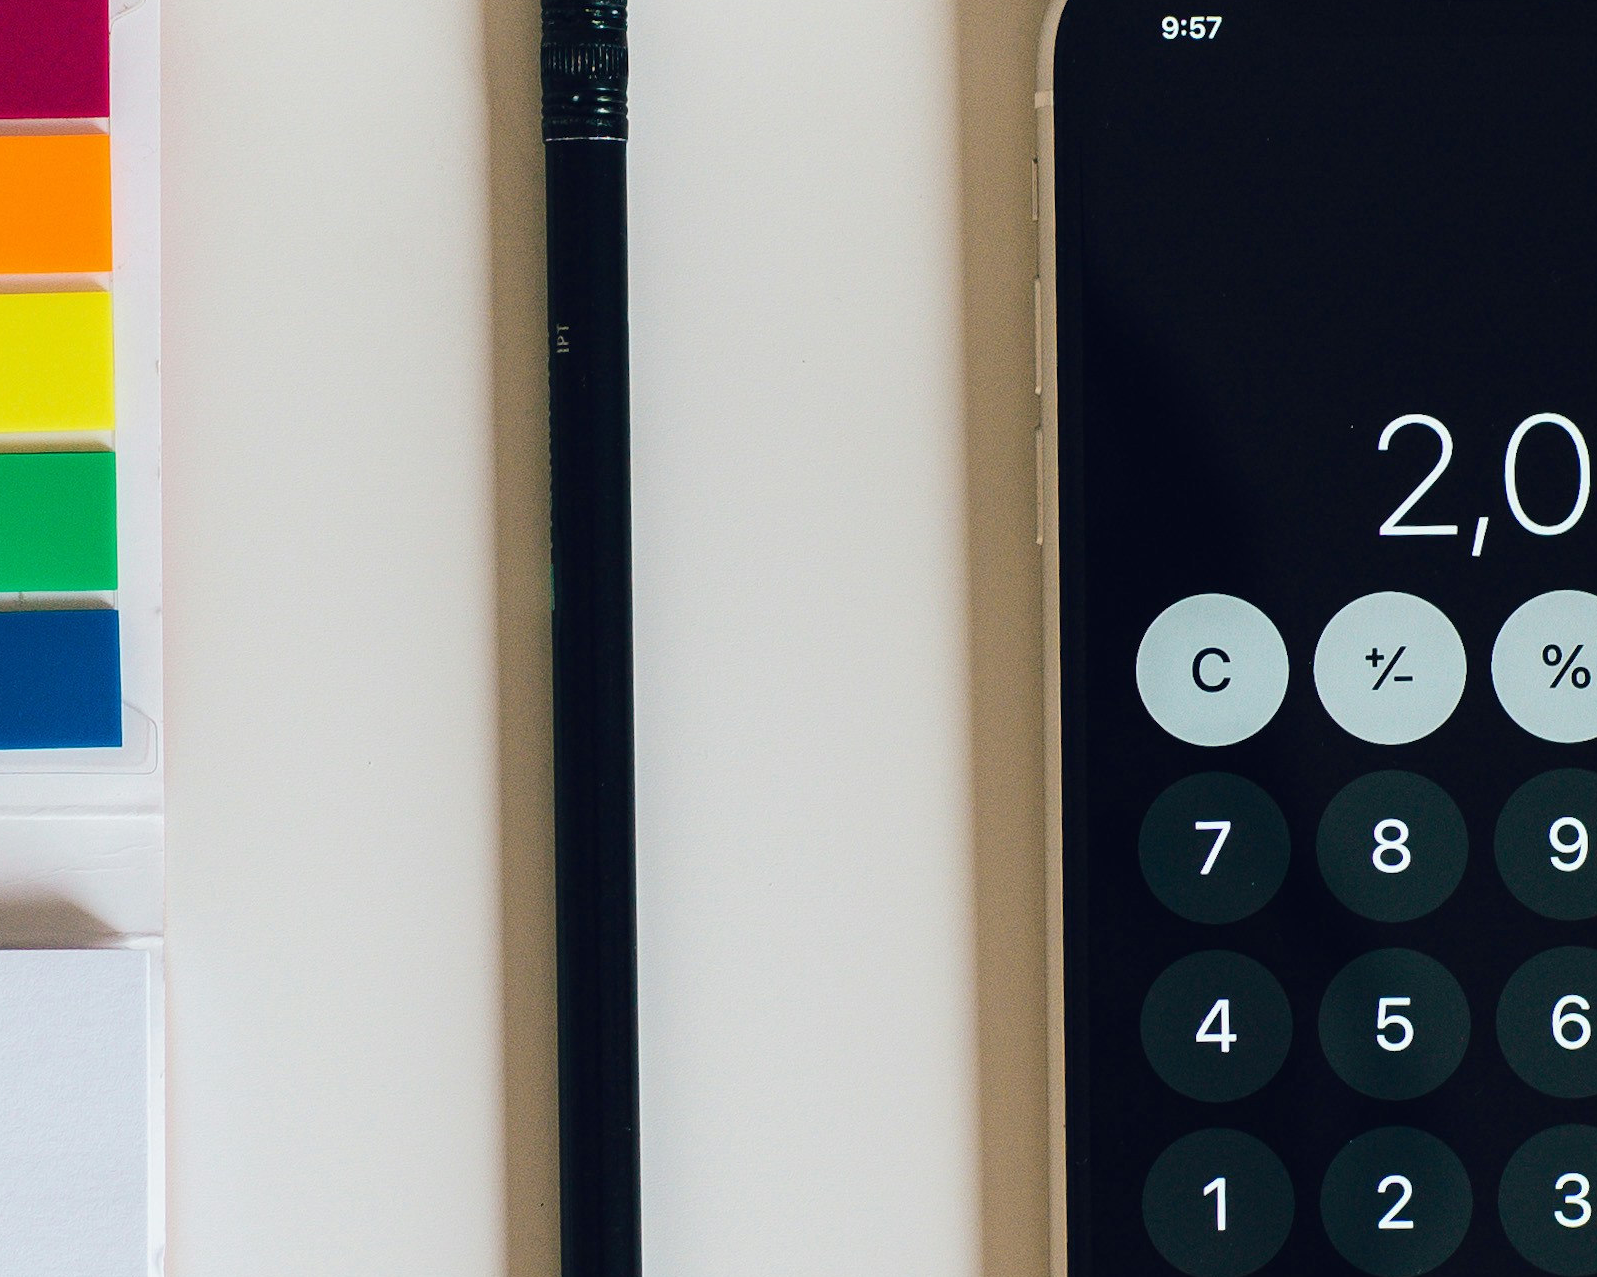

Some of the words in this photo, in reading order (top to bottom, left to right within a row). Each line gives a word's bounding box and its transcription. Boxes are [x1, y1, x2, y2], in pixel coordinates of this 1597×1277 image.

[1162, 16, 1222, 39] 9:57
[1192, 648, 1230, 692] C
[1543, 645, 1591, 689] %
[1195, 821, 1231, 874] 7
[1373, 819, 1411, 873] 8
[1549, 817, 1588, 871] 9
[1196, 999, 1237, 1052] 4
[1377, 998, 1413, 1051] 5
[1552, 995, 1591, 1049] 6
[1204, 1178, 1226, 1230] 1
[1378, 1175, 1413, 1229] 2
[1555, 1173, 1591, 1227] 3
